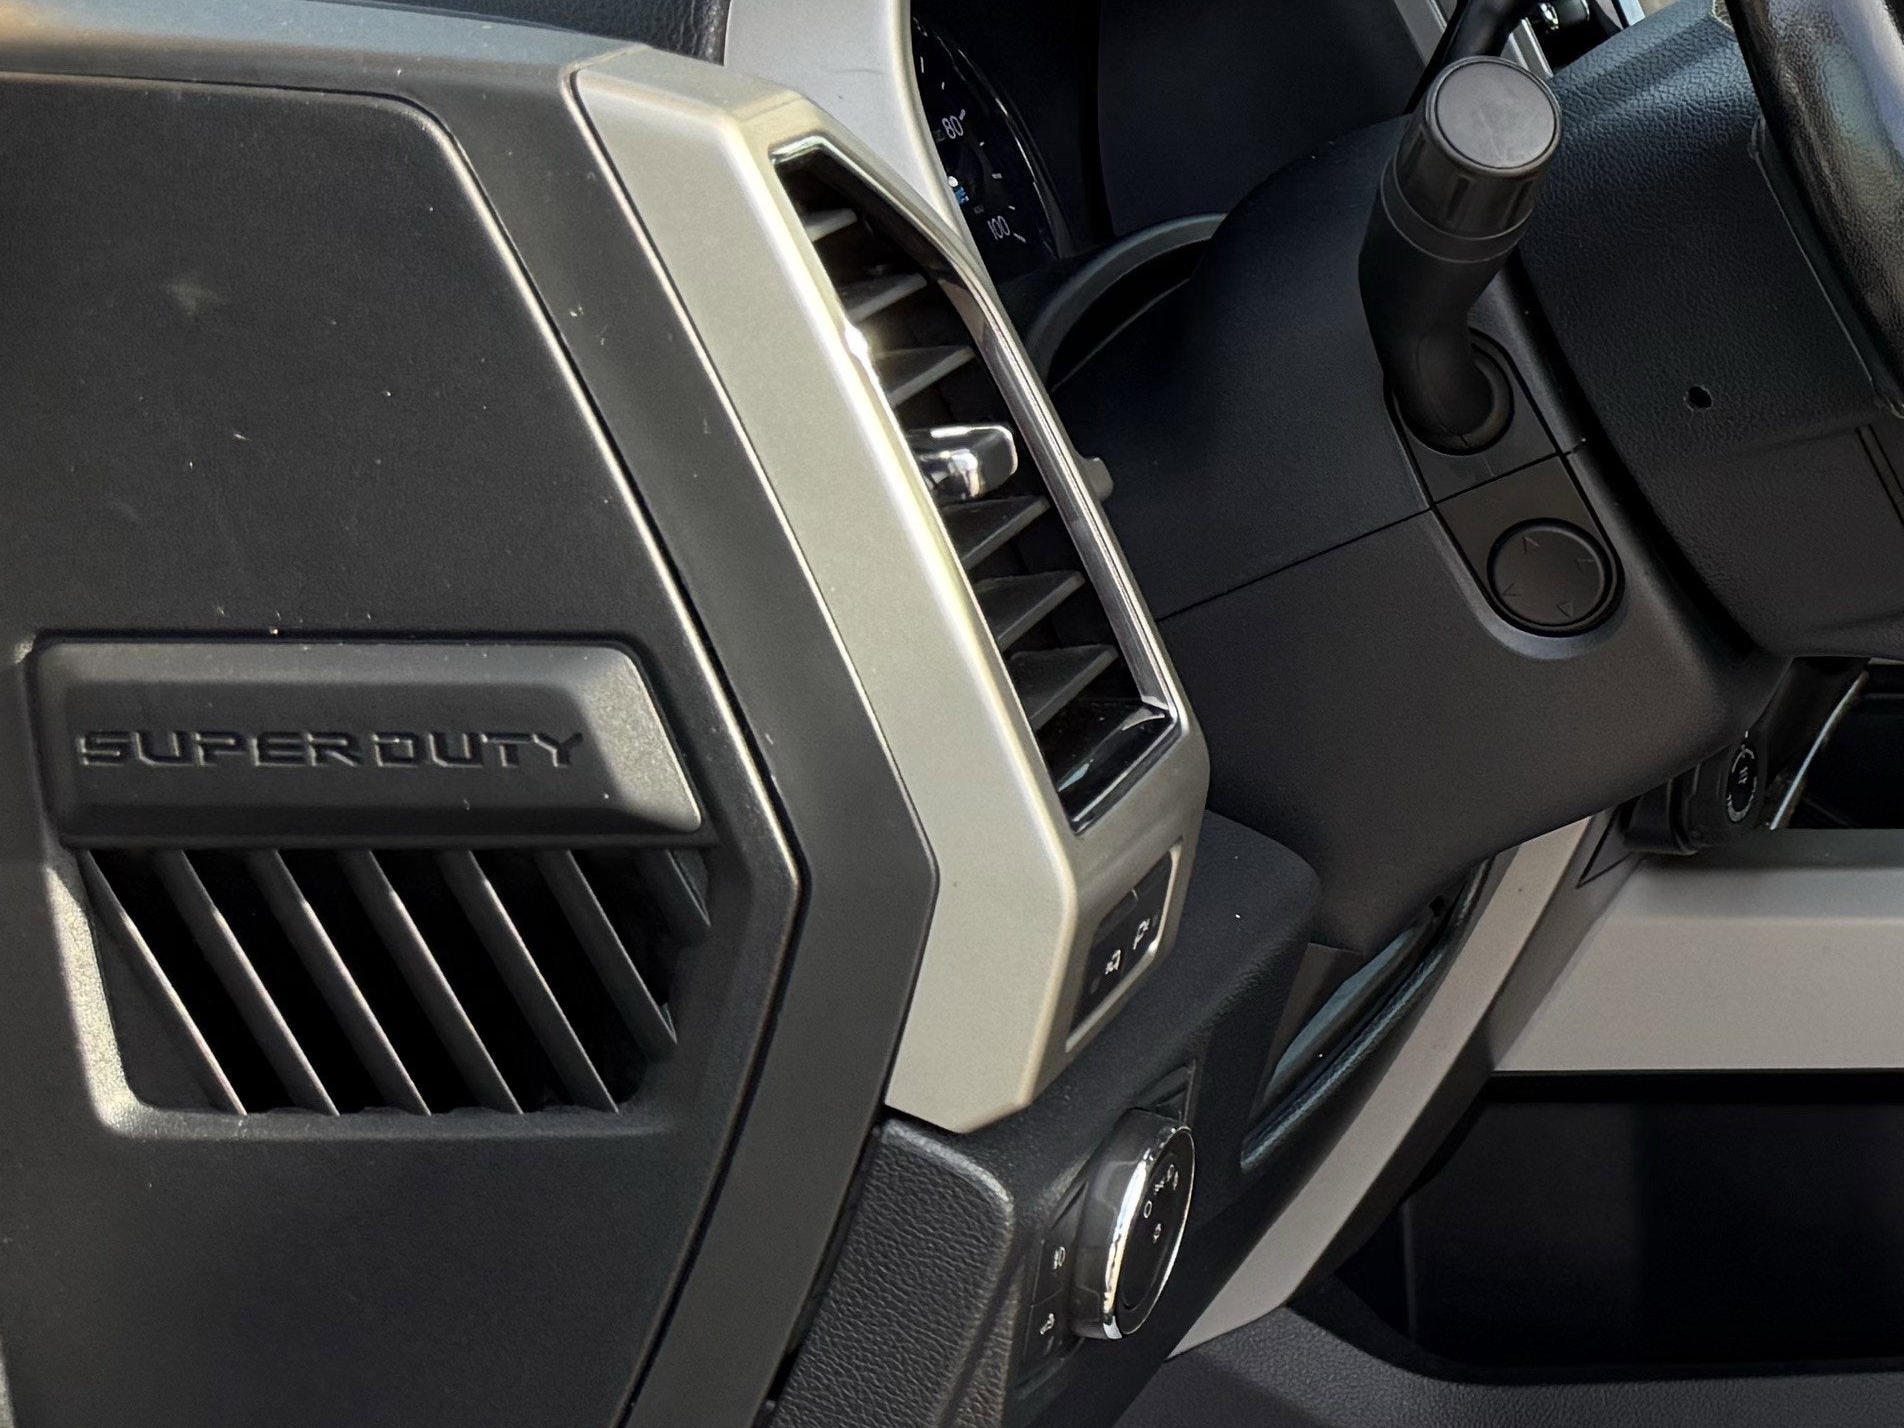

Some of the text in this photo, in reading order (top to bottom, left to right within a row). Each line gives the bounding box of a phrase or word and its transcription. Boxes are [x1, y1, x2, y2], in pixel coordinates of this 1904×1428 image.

[941, 115, 965, 140] 80
[986, 215, 1011, 242] 100
[78, 729, 586, 769] SUPER DUTY
